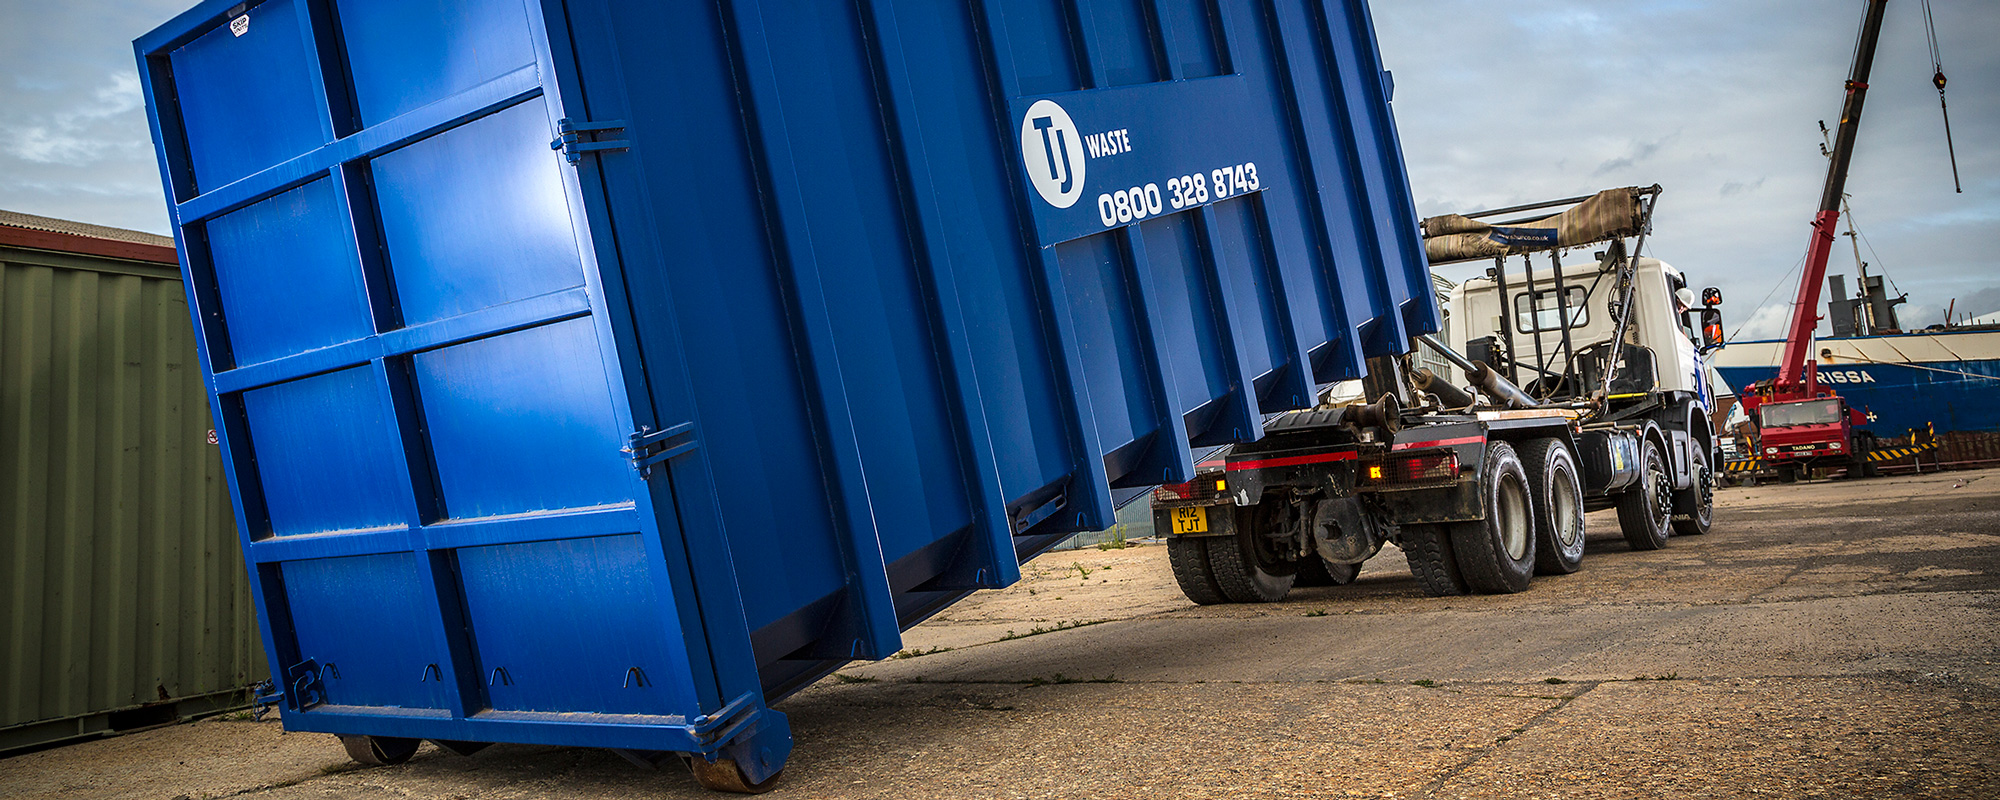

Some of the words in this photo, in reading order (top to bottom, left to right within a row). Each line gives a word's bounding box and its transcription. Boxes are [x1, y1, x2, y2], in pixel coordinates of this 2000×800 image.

[1031, 116, 1073, 194] TJ
[1085, 129, 1132, 159] WASTE
[1098, 183, 1163, 227] 0800
[1167, 172, 1209, 209] 328
[1211, 162, 1260, 200] 8743
[1178, 517, 1200, 532] TJT
